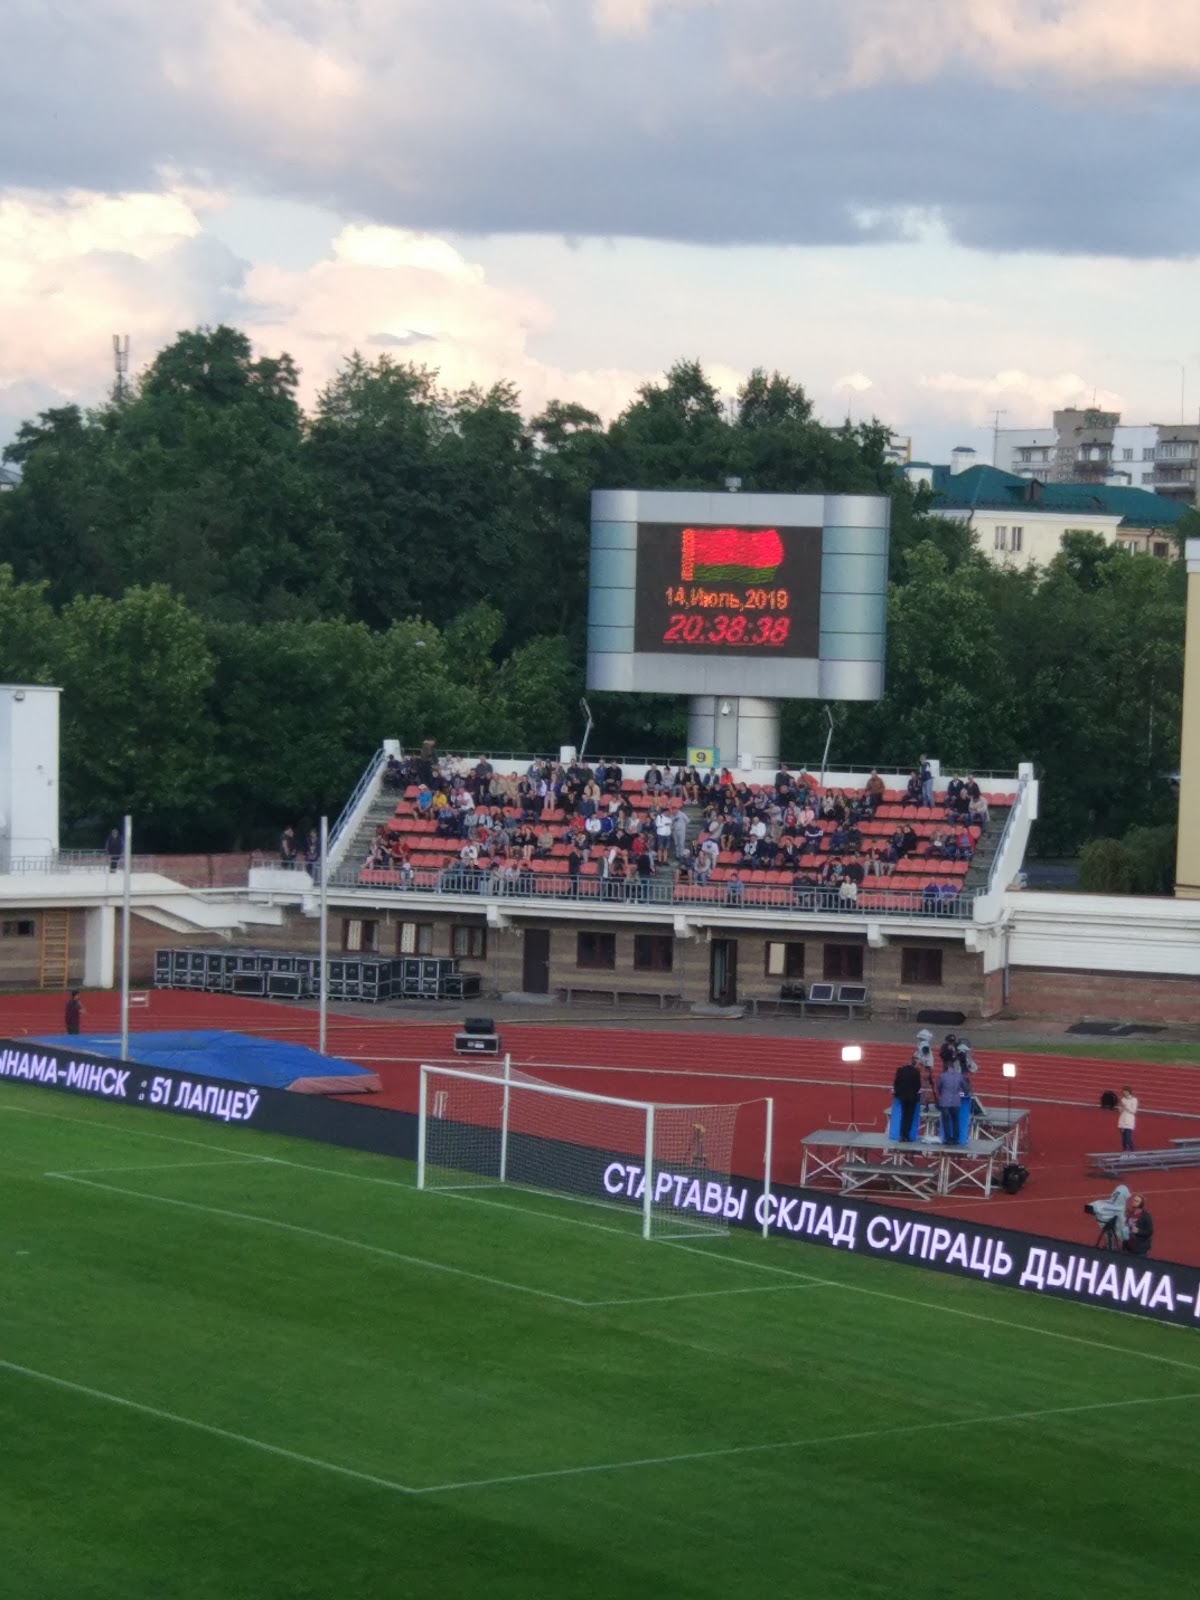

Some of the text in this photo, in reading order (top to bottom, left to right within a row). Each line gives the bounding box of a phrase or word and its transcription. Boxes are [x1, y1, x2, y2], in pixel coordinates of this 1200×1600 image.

[662, 613, 791, 643] 20:38:38
[695, 751, 707, 763] 9
[174, 1081, 260, 1122] ЛАПЦЕЎ
[754, 1193, 858, 1249] СКЛАД
[866, 1215, 1013, 1278] СУПРАЦЬ
[1019, 1246, 1200, 1317] ДЫНАМА-
